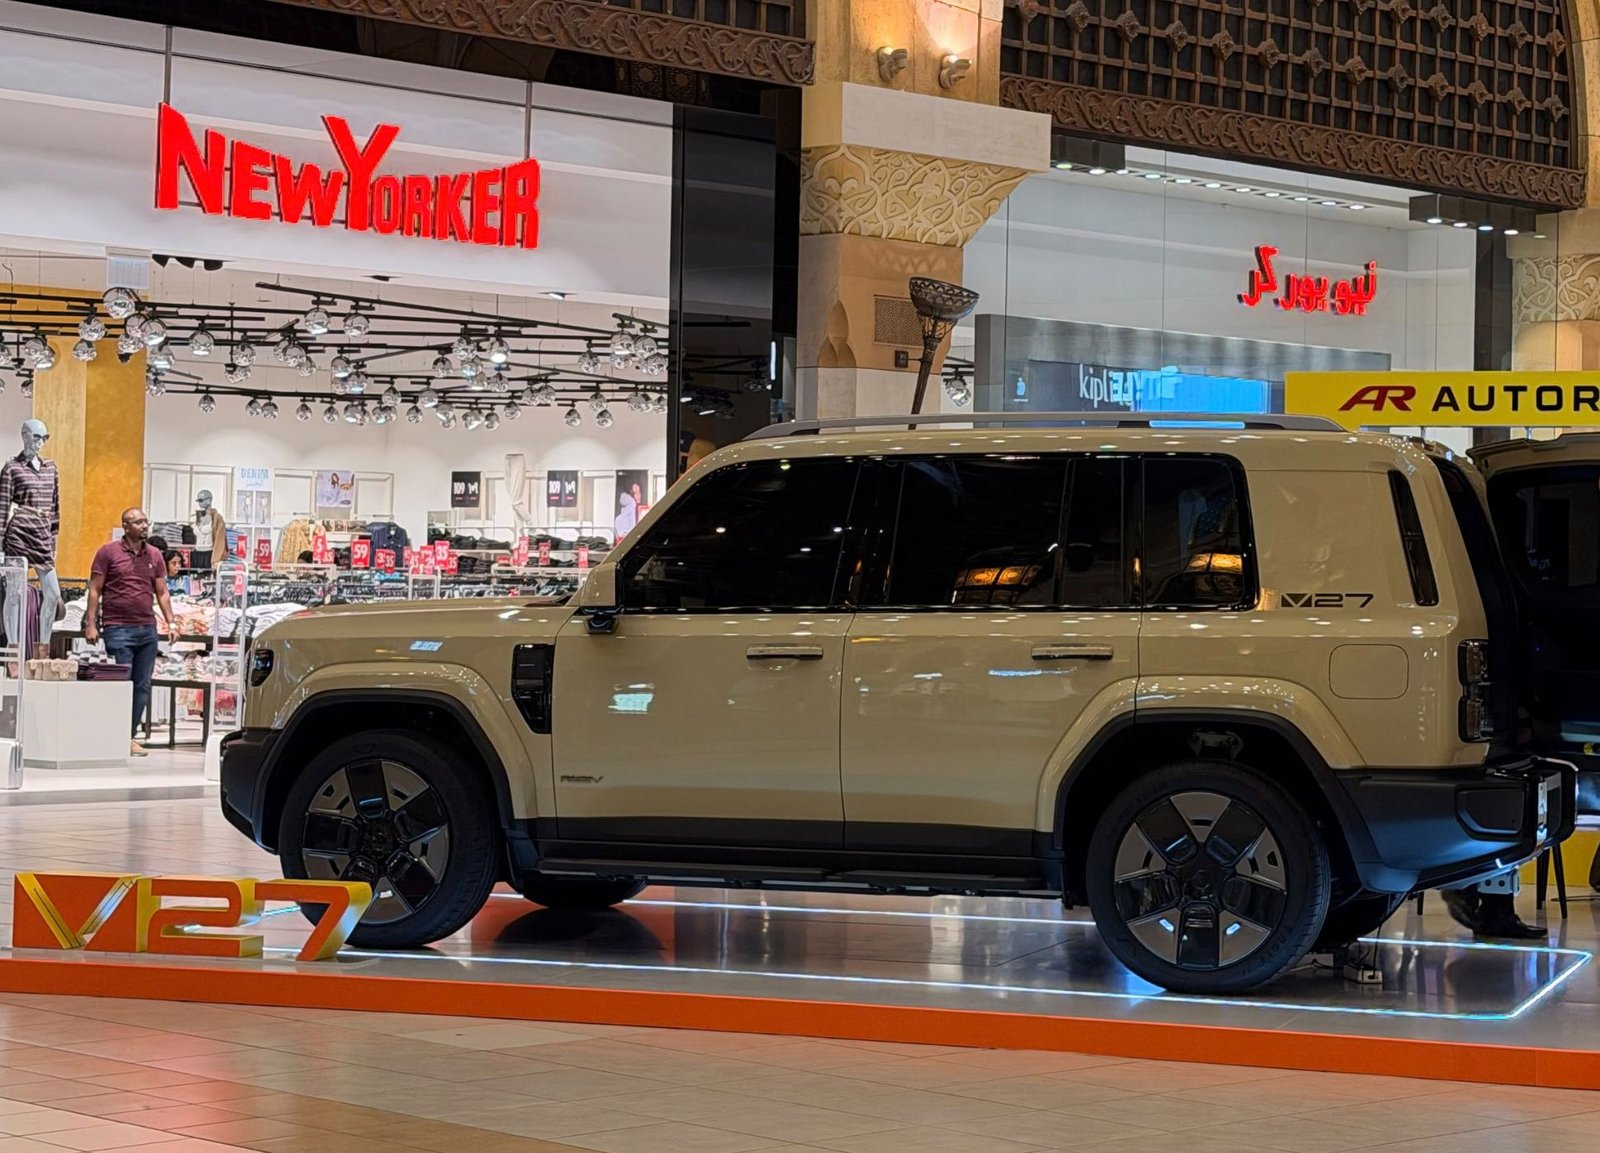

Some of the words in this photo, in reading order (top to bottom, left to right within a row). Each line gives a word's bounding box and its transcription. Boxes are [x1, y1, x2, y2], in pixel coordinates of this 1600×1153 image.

[1431, 385, 1600, 412] AUTOR
[240, 468, 269, 479] DENIM
[259, 543, 270, 557] 59
[353, 544, 368, 558] 59
[437, 545, 448, 558] 35
[385, 555, 394, 567] 35
